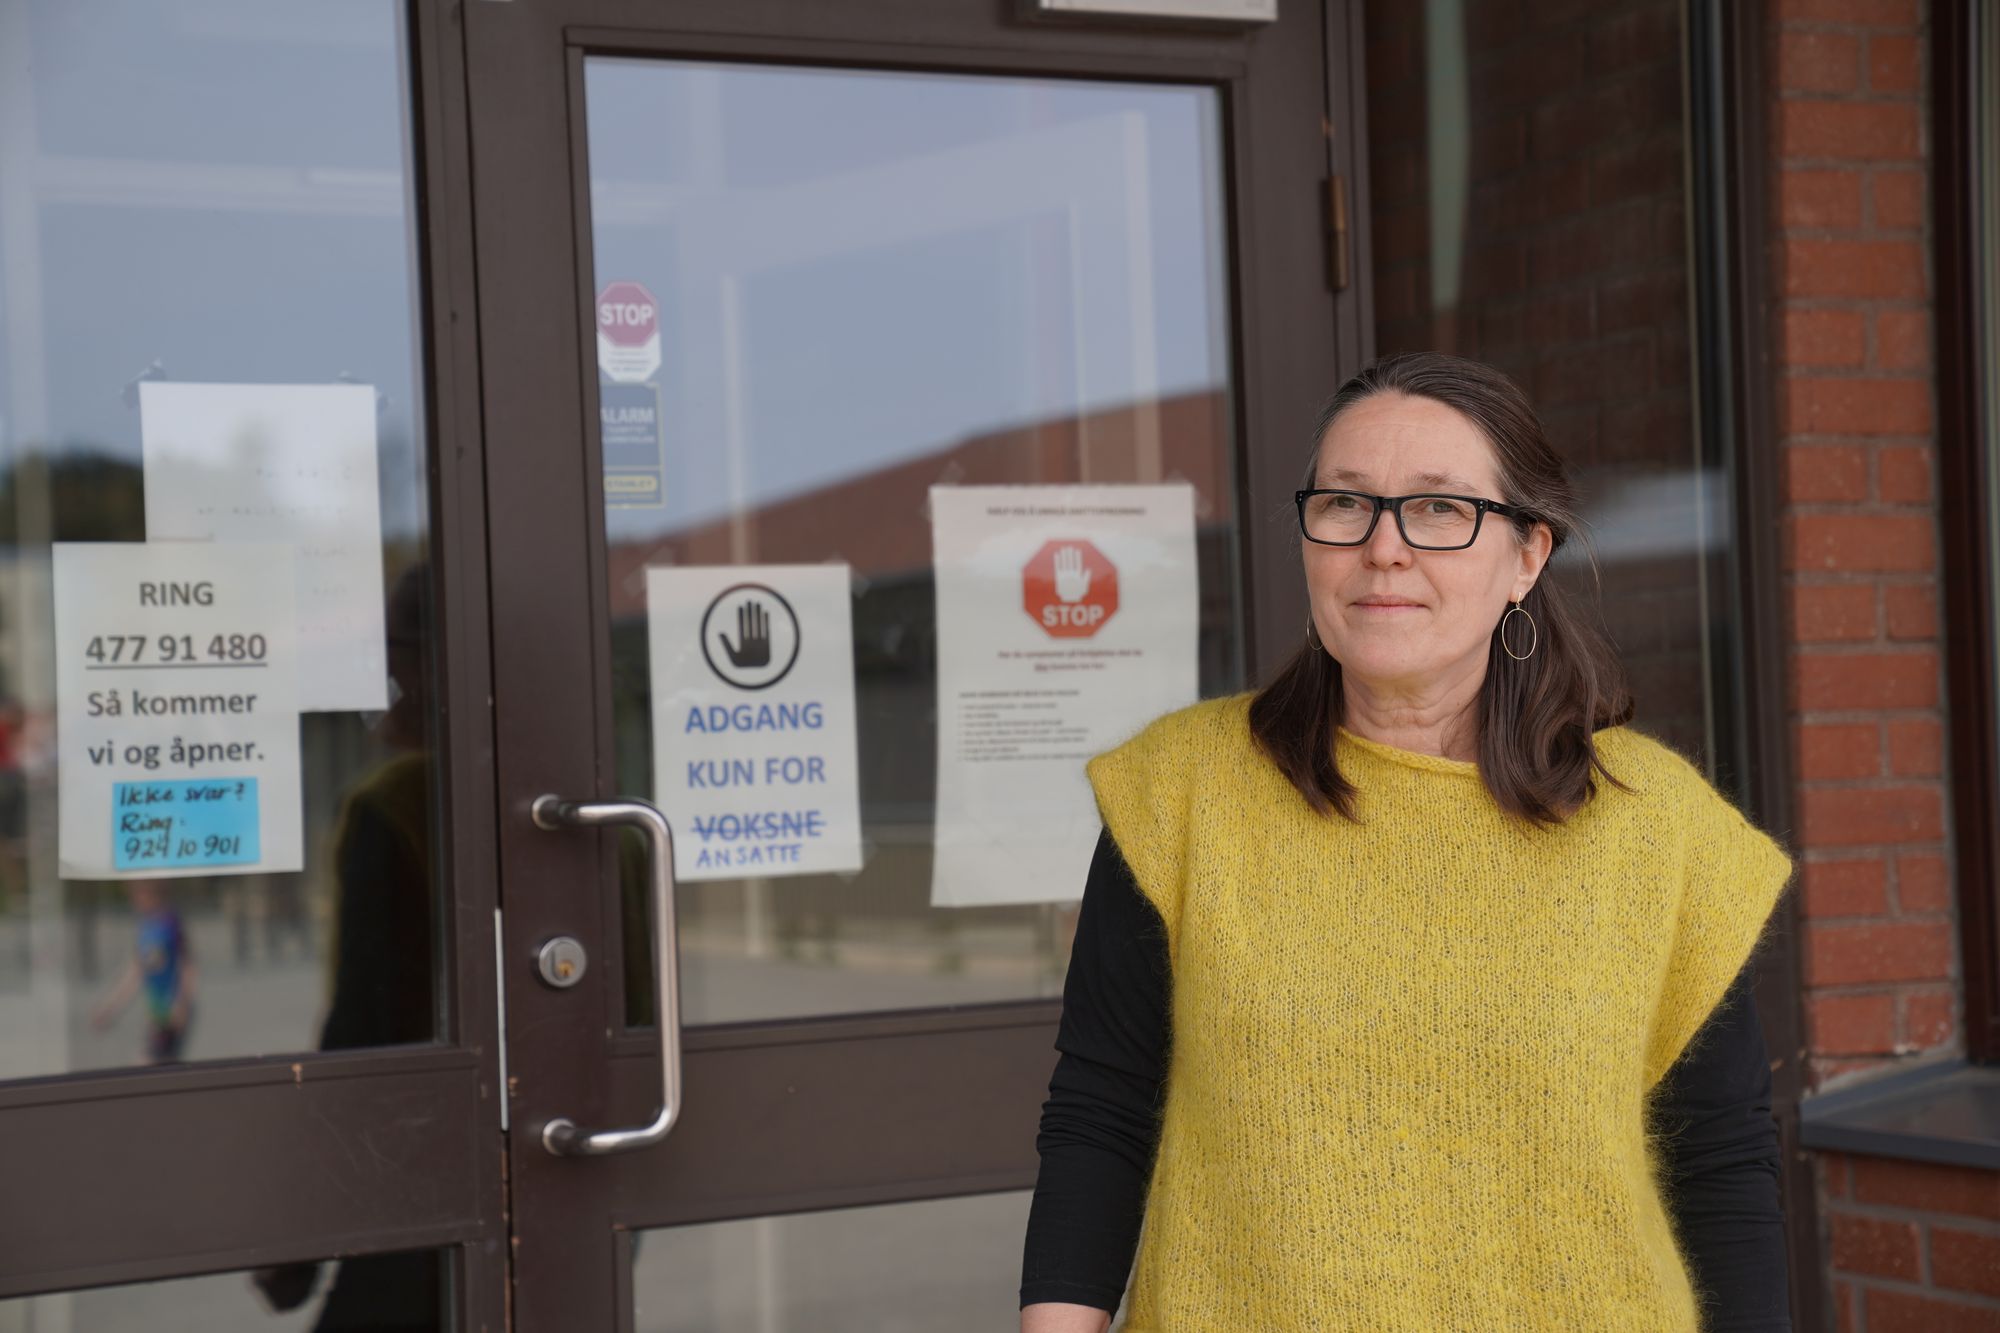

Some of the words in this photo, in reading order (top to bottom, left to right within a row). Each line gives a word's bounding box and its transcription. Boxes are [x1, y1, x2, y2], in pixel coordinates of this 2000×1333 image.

[600, 303, 653, 326] STOP
[139, 581, 214, 607] RING
[1042, 604, 1105, 627] STOP
[86, 635, 146, 663] 477
[158, 635, 197, 662] 91
[207, 634, 267, 661] 480
[87, 689, 122, 717] Så
[132, 689, 257, 716] kommer
[685, 702, 824, 734] ADGANG
[88, 739, 114, 766] vi
[124, 743, 160, 770] og
[170, 736, 264, 768] åpner.
[687, 758, 754, 789] KUN
[765, 756, 826, 785] FOR
[120, 784, 174, 807] Ikke
[693, 809, 823, 843] VOKSNE
[125, 834, 170, 861] 924
[177, 838, 197, 859] 10
[204, 833, 241, 857] 901
[696, 844, 802, 868] ANSATTE
